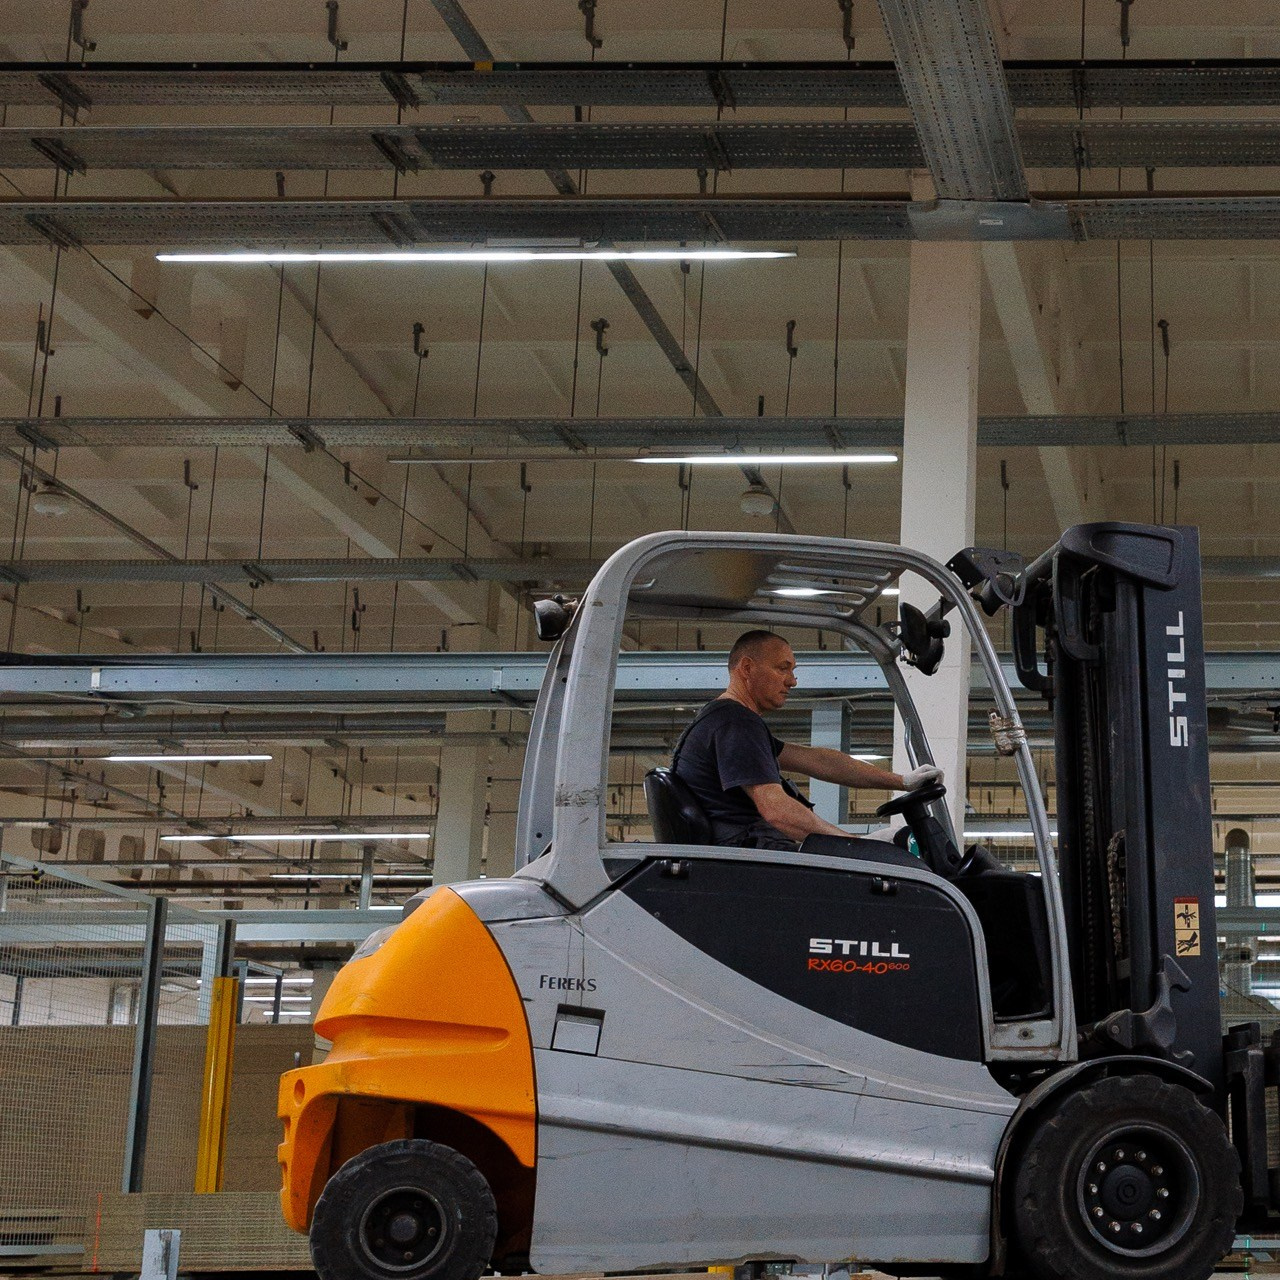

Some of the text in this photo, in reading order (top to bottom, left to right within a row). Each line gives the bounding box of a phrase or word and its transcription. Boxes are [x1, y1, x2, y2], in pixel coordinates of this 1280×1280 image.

[1166, 611, 1188, 746] STILL
[809, 938, 910, 958] STILL
[539, 974, 597, 992] FEREKS
